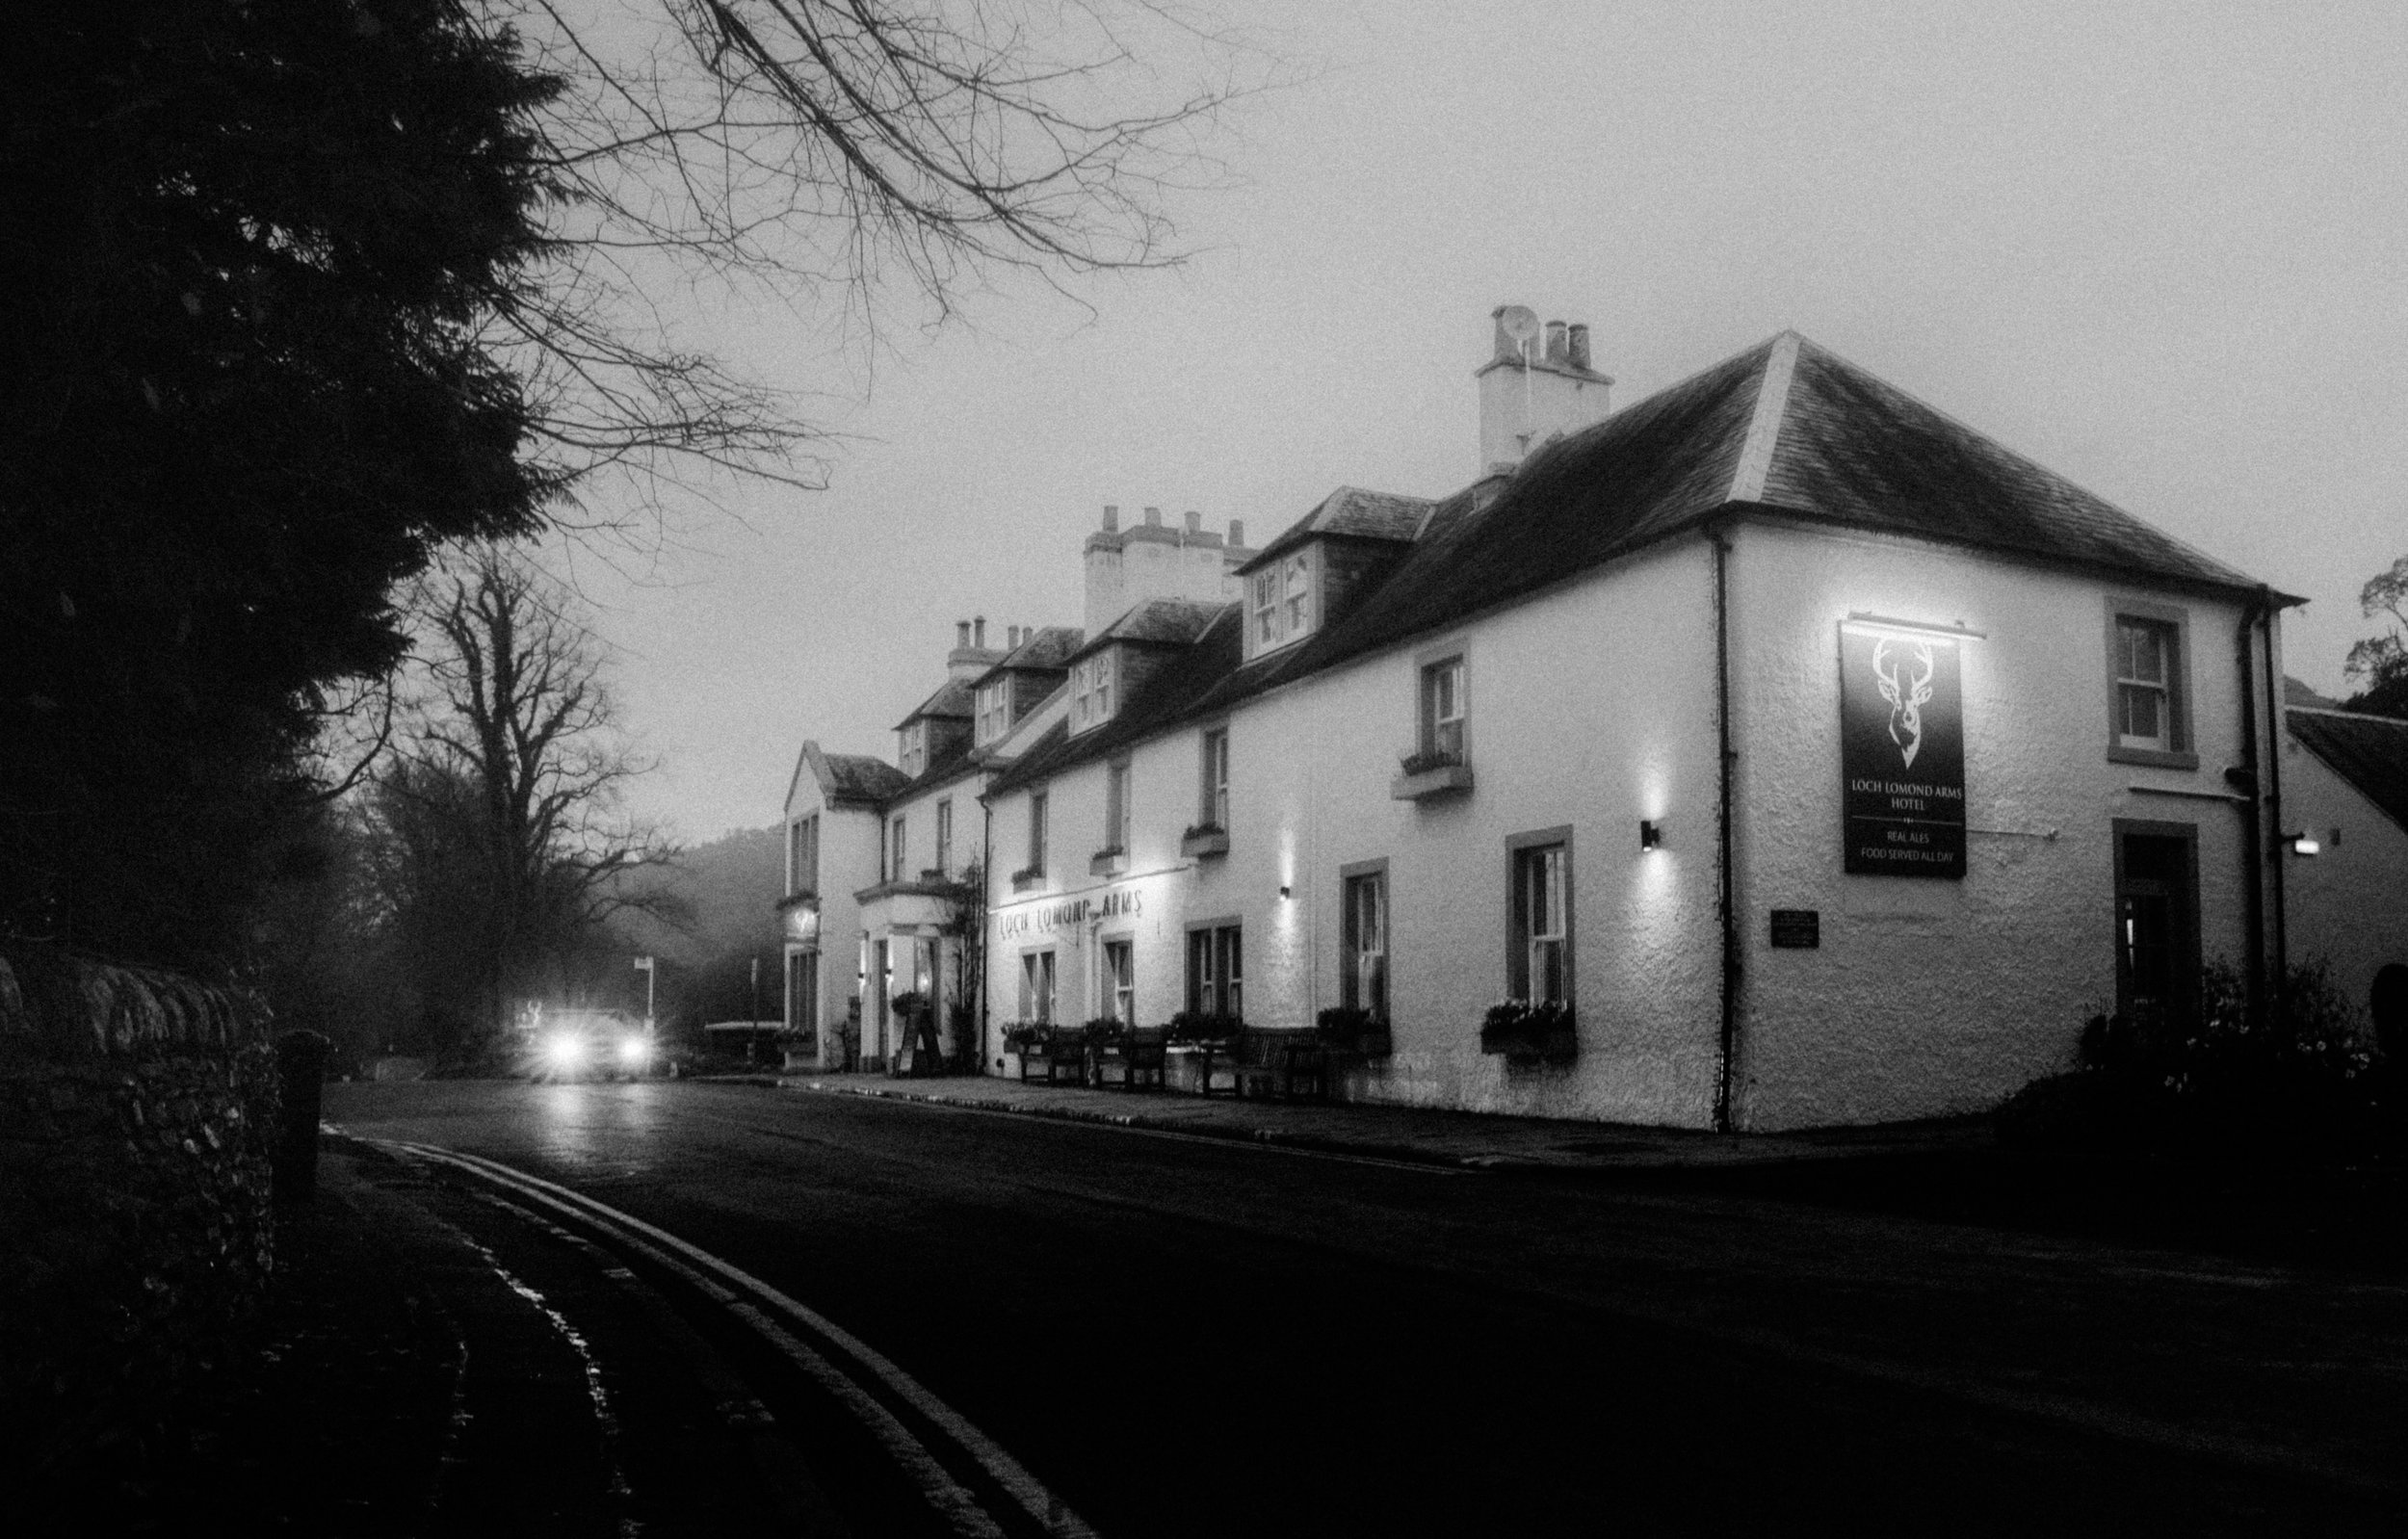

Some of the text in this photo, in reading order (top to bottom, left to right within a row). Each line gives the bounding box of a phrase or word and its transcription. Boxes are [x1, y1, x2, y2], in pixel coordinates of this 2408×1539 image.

[1851, 779, 1963, 800] LOCH LOMOND ARMS
[1891, 797, 1925, 811] HOTEL
[1887, 830, 1929, 844] REAL ALES
[1861, 848, 1954, 863] FOOD SERVED ALL DAY
[999, 912, 1029, 937] LOCH
[1102, 889, 1142, 917] ARMS
